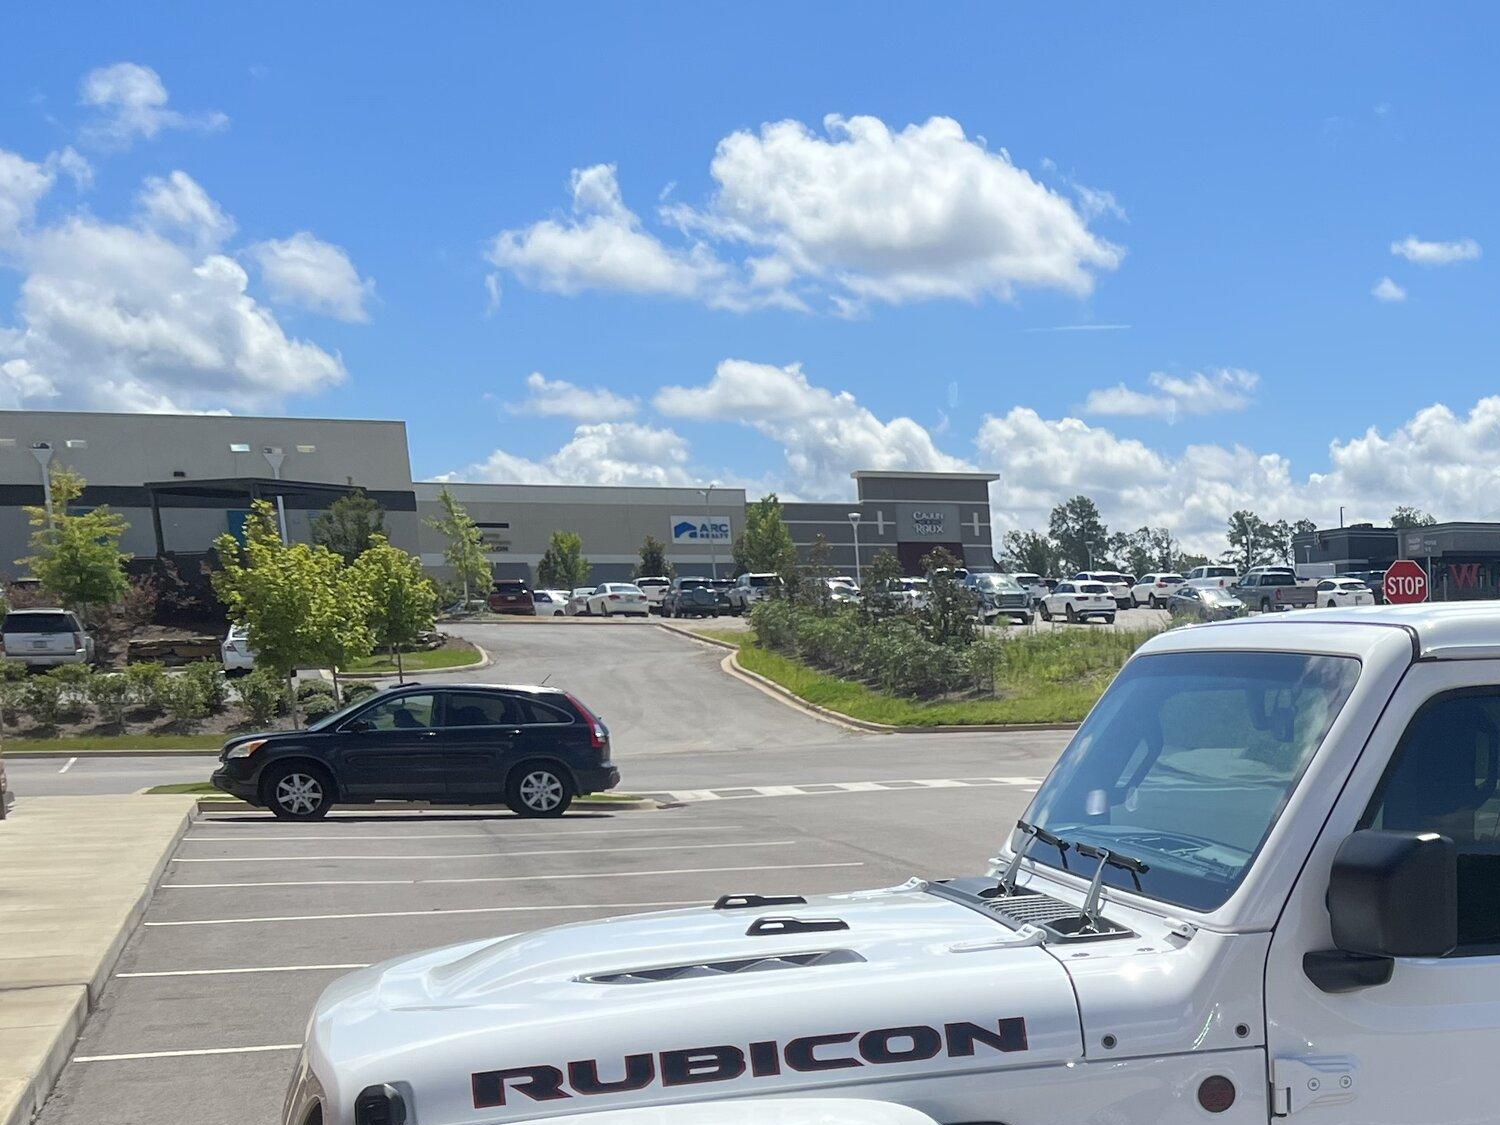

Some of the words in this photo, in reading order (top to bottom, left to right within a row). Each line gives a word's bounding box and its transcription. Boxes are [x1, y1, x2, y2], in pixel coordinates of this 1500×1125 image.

[700, 523, 728, 533] ARC
[1387, 576, 1425, 595] STOP
[470, 1016, 1029, 1110] RUBICON
